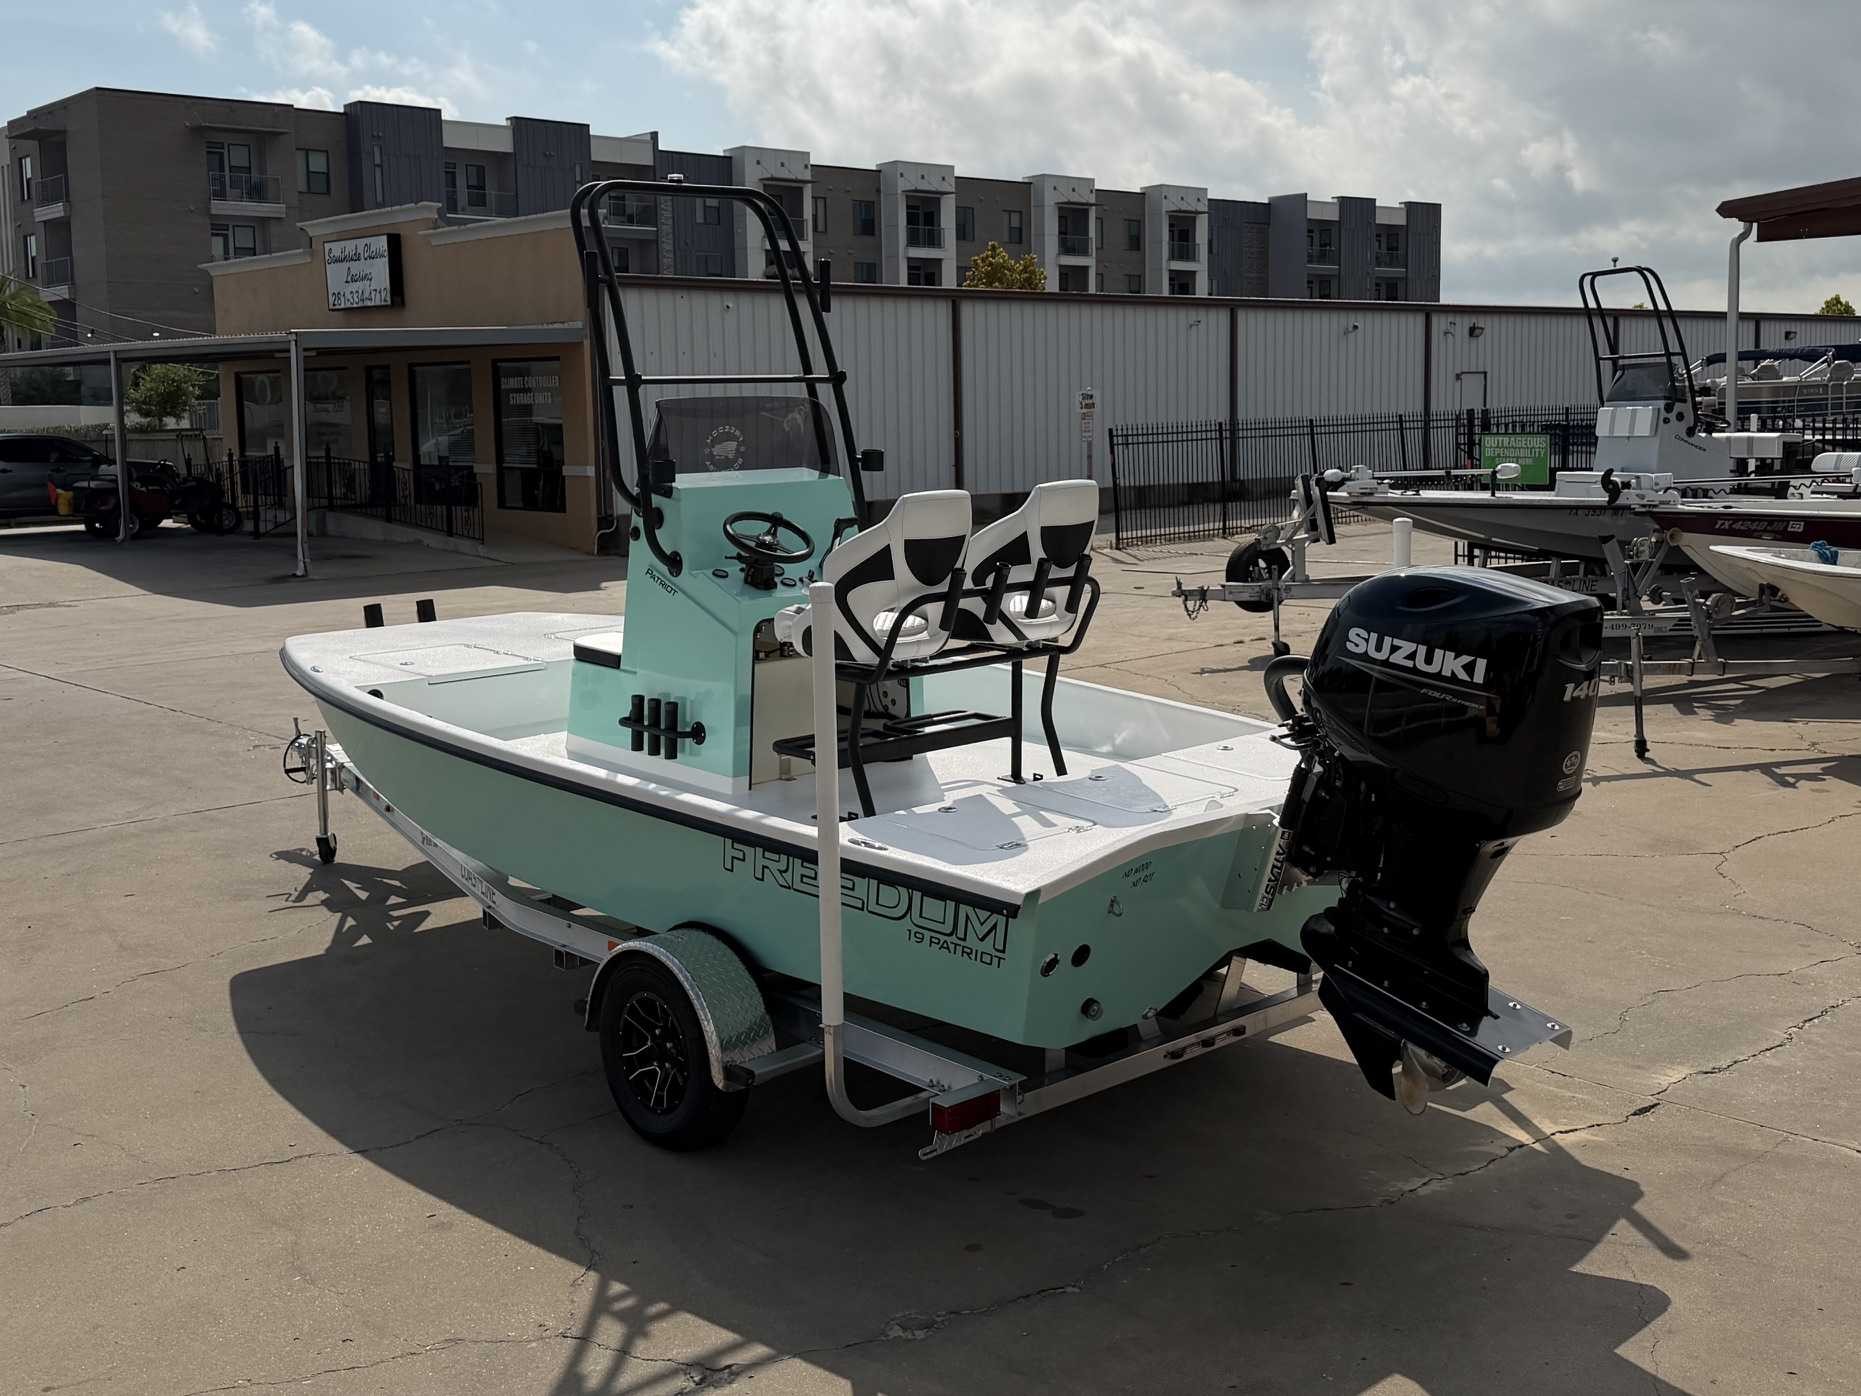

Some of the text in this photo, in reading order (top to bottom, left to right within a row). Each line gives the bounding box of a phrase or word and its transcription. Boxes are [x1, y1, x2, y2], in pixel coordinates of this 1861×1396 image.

[327, 242, 388, 265] Southside Classic
[344, 266, 373, 288] Leasing
[331, 287, 390, 307] 281-334-4712
[1484, 436, 1547, 448] OUTRAGEOUS
[1485, 447, 1545, 457] DEPENDABILITY
[1715, 519, 1733, 529] TX
[645, 567, 679, 597] PATRIOT
[1346, 627, 1488, 684] SUZUKI
[722, 837, 1010, 954] FREEDOM
[907, 928, 1006, 969] 19 PATRIOT
